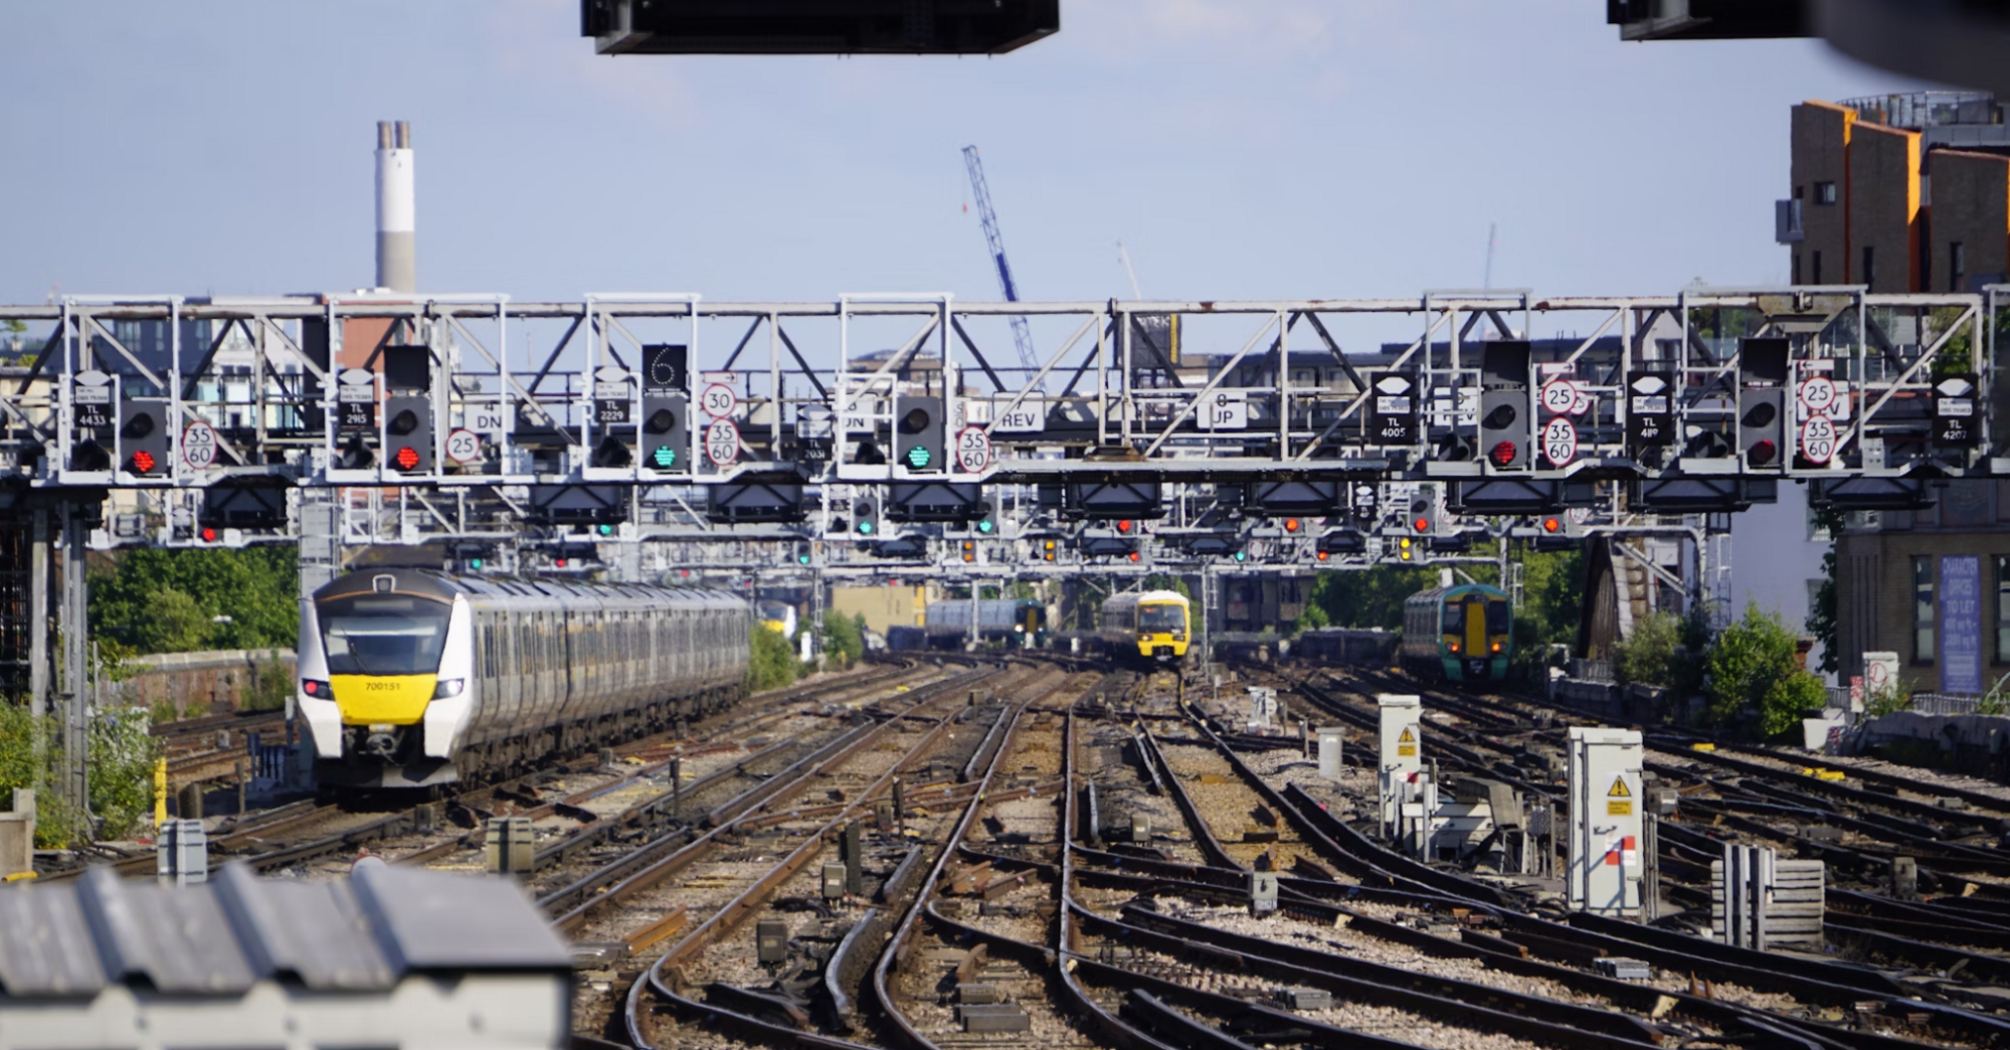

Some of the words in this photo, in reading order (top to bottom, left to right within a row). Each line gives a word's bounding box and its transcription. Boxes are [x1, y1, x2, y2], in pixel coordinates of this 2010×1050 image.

[1550, 389, 1570, 405] 25
[1808, 385, 1829, 401] 25
[350, 403, 364, 413] TL
[605, 400, 619, 410] TL
[709, 393, 730, 409] 30
[85, 404, 99, 414] TL
[600, 410, 624, 421] 2229
[79, 414, 107, 426] 4433
[346, 413, 367, 425] 2915
[477, 416, 502, 429] DN
[1002, 413, 1036, 427] REV
[1387, 417, 1400, 427] TL
[1642, 417, 1656, 427] TL
[1948, 419, 1962, 429] TL
[189, 428, 211, 443] 35
[712, 425, 732, 441] 35
[1381, 428, 1406, 438] 4005
[1550, 424, 1570, 440] 35
[1640, 427, 1659, 438] 4119
[1809, 422, 1830, 437] 35
[1942, 430, 1967, 440] 4207
[452, 438, 473, 453] 25
[808, 439, 821, 449] TL
[963, 433, 984, 448] 35
[712, 444, 733, 459] 60
[1550, 443, 1570, 459] 60
[1809, 441, 1830, 456] 60
[189, 448, 211, 464] 60
[964, 452, 984, 467] 60
[1946, 600, 1959, 614] TO
[1960, 600, 1975, 614] LET
[365, 682, 401, 691] 700151
